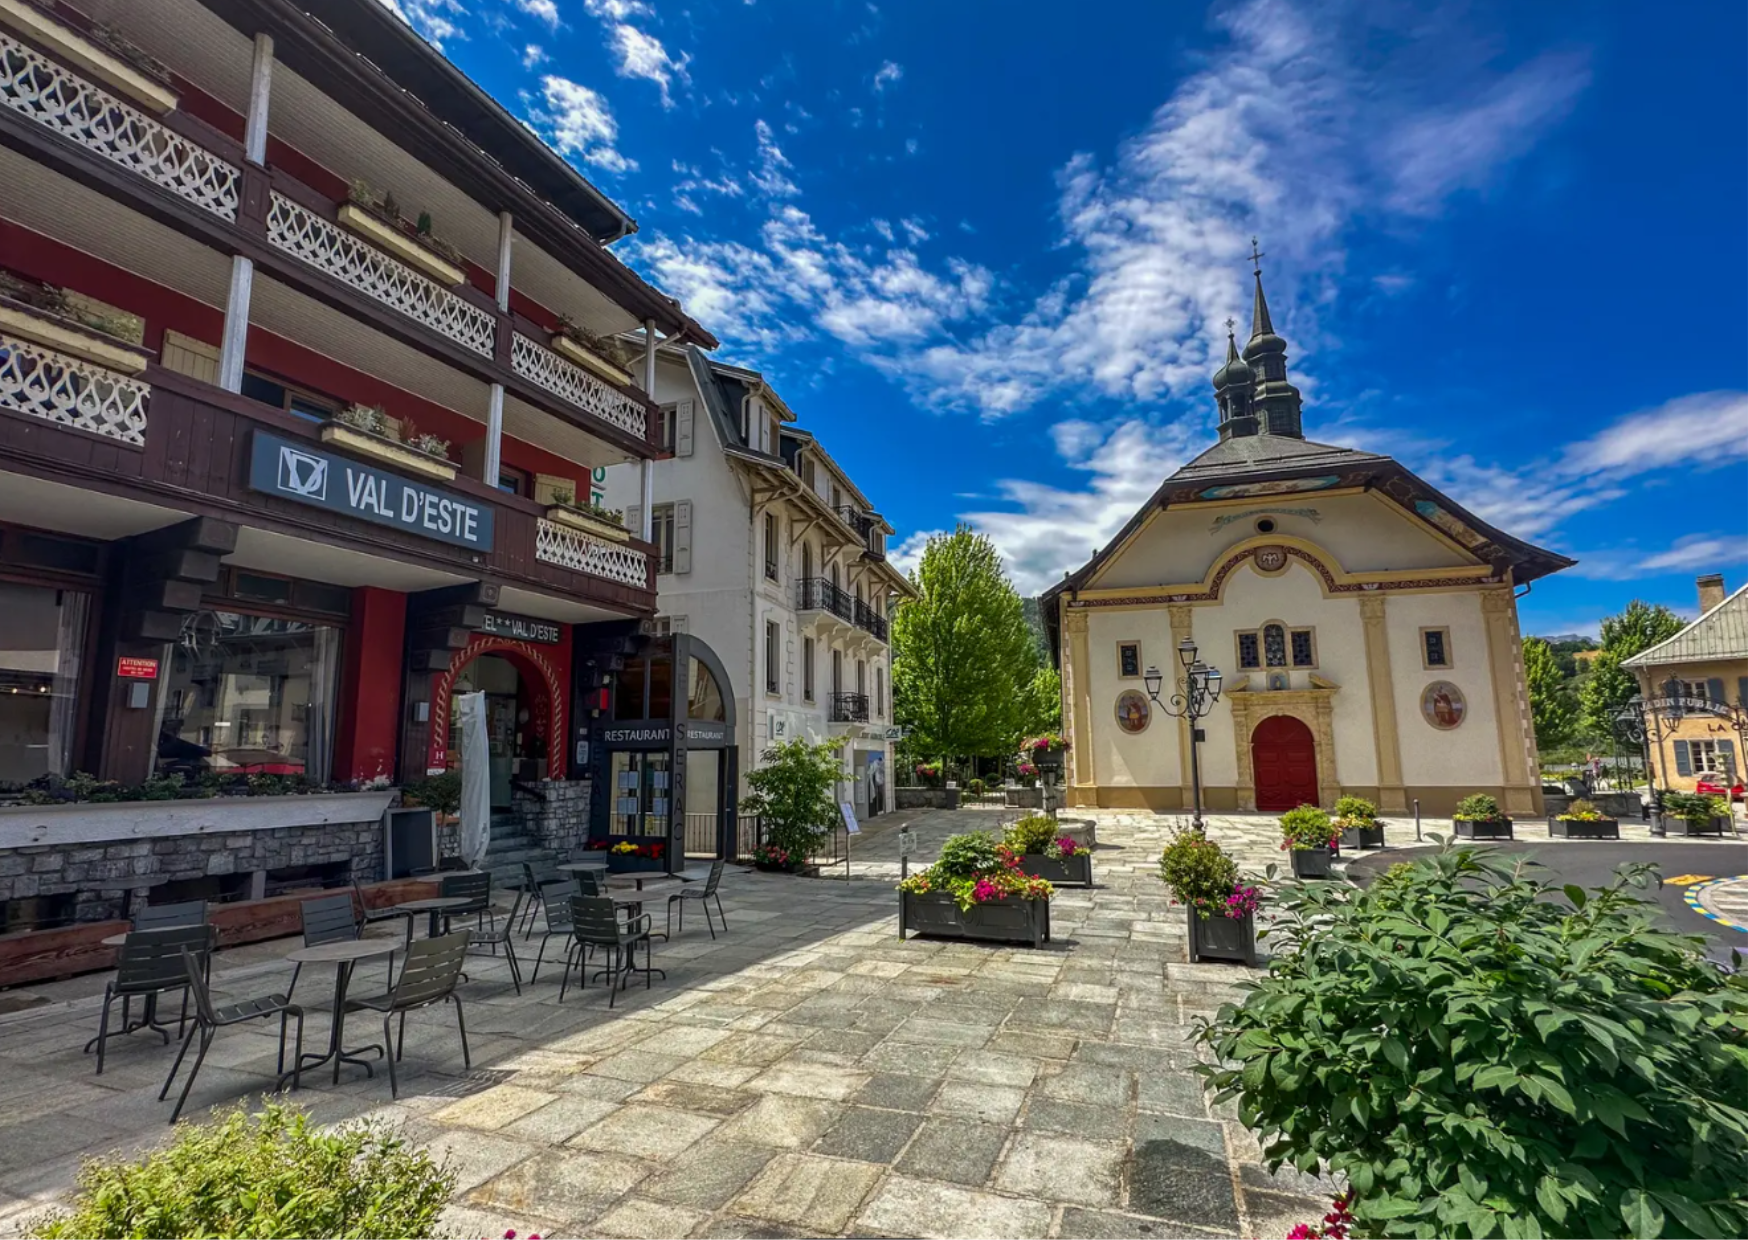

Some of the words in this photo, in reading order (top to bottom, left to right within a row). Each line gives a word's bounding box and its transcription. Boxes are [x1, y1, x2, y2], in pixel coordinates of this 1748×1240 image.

[346, 467, 394, 518] VAL
[401, 486, 478, 542] D'ESTE
[511, 620, 528, 637] VAL
[530, 623, 559, 642] D'ESTE
[604, 728, 670, 741] RESTAURANT
[687, 730, 724, 739] RESTAURANT
[1707, 723, 1727, 733] LA
[673, 723, 686, 841] SERAC
